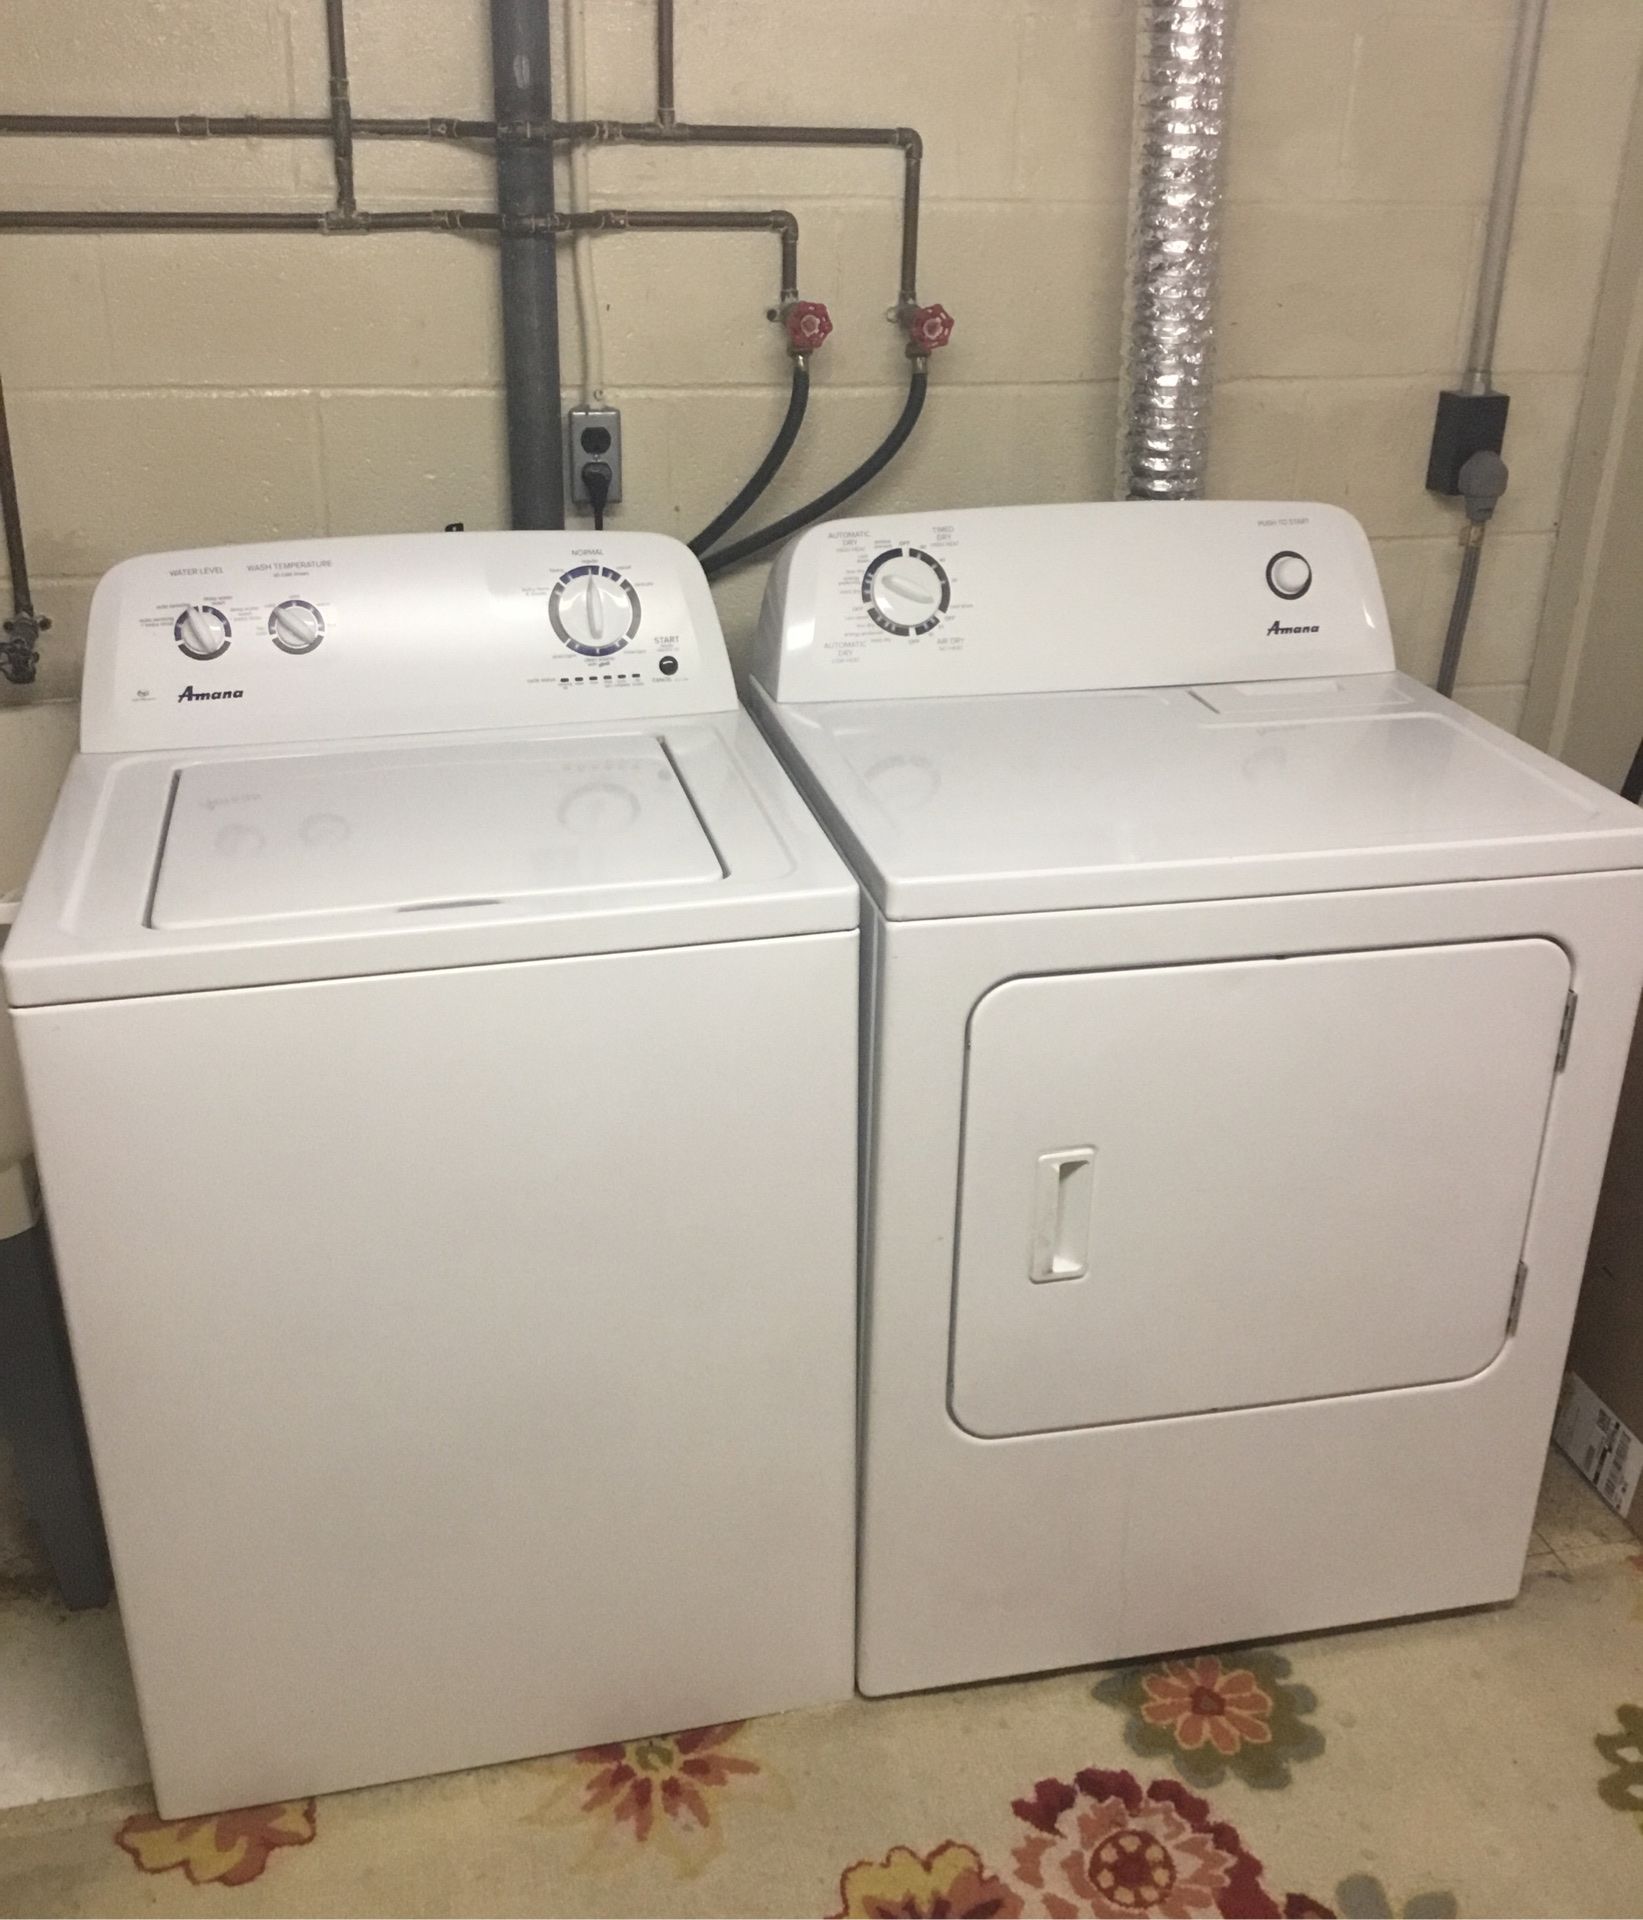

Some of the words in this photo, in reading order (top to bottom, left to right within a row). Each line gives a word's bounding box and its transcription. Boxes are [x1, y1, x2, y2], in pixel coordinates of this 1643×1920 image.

[828, 531, 870, 539] AUTOMATIC
[936, 533, 951, 541] DRY
[274, 560, 333, 570] TEMPERATURE
[169, 567, 198, 576] WATER
[200, 566, 224, 574] LEVEL
[1267, 620, 1320, 636] Amana
[654, 636, 680, 644] START
[824, 641, 866, 649] AUTOMATIC
[178, 685, 244, 703] Amana
